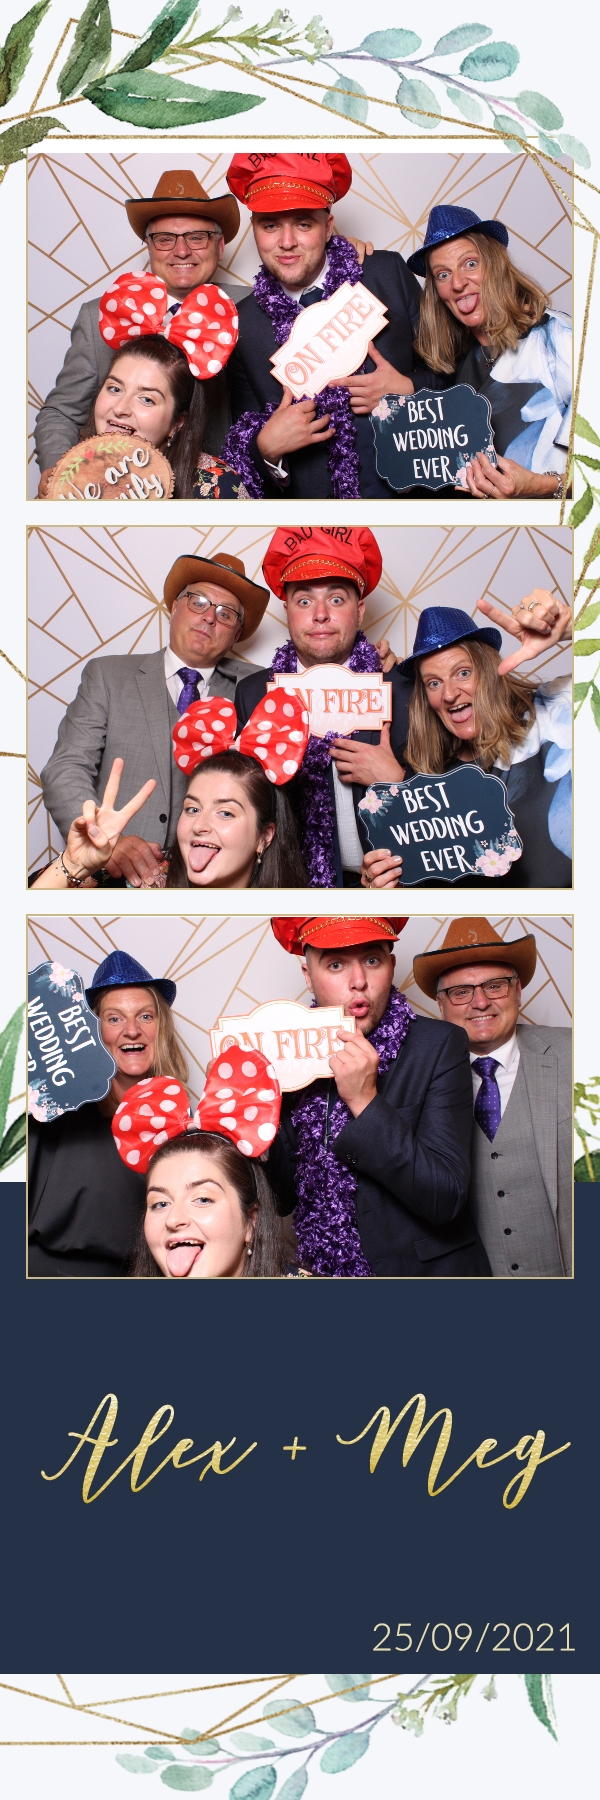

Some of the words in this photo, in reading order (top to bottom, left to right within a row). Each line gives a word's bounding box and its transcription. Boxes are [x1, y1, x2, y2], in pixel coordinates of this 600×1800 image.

[284, 342, 325, 386] ON
[313, 293, 375, 353] FIRE
[407, 397, 444, 423] BEST
[392, 424, 469, 452] WEDDING
[105, 447, 149, 485] are
[413, 455, 457, 483] EVER
[292, 687, 314, 715] N
[320, 688, 384, 715] FIRE
[402, 782, 450, 814] BEST
[389, 810, 485, 846] WEDDING
[420, 845, 475, 873] EVER
[28, 995, 75, 1087] WEDDING
[58, 1004, 97, 1053] BEST
[271, 1025, 343, 1061] FIRE
